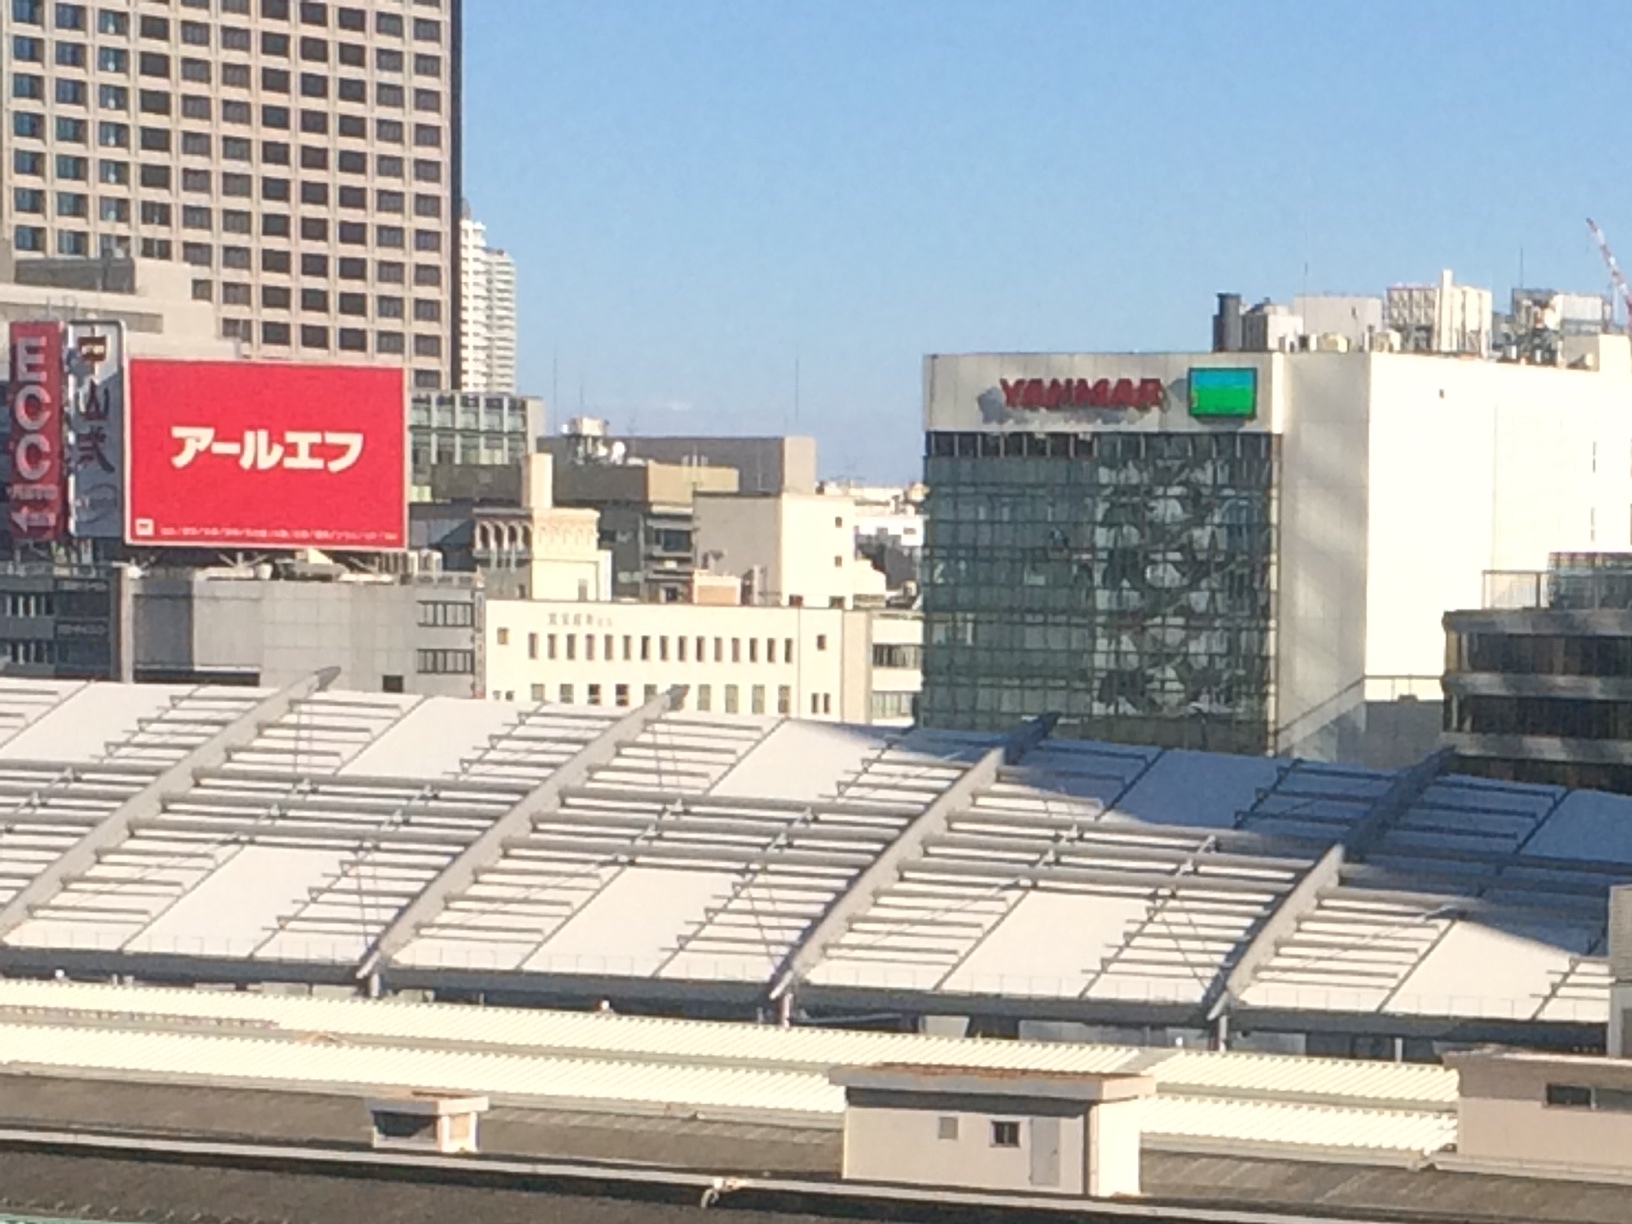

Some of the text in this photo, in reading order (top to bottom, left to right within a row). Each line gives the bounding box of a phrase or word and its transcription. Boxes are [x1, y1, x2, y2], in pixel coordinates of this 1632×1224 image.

[16, 336, 51, 480] ECC
[1000, 377, 1164, 410] YANMAR
[171, 426, 364, 473] アールエフ
